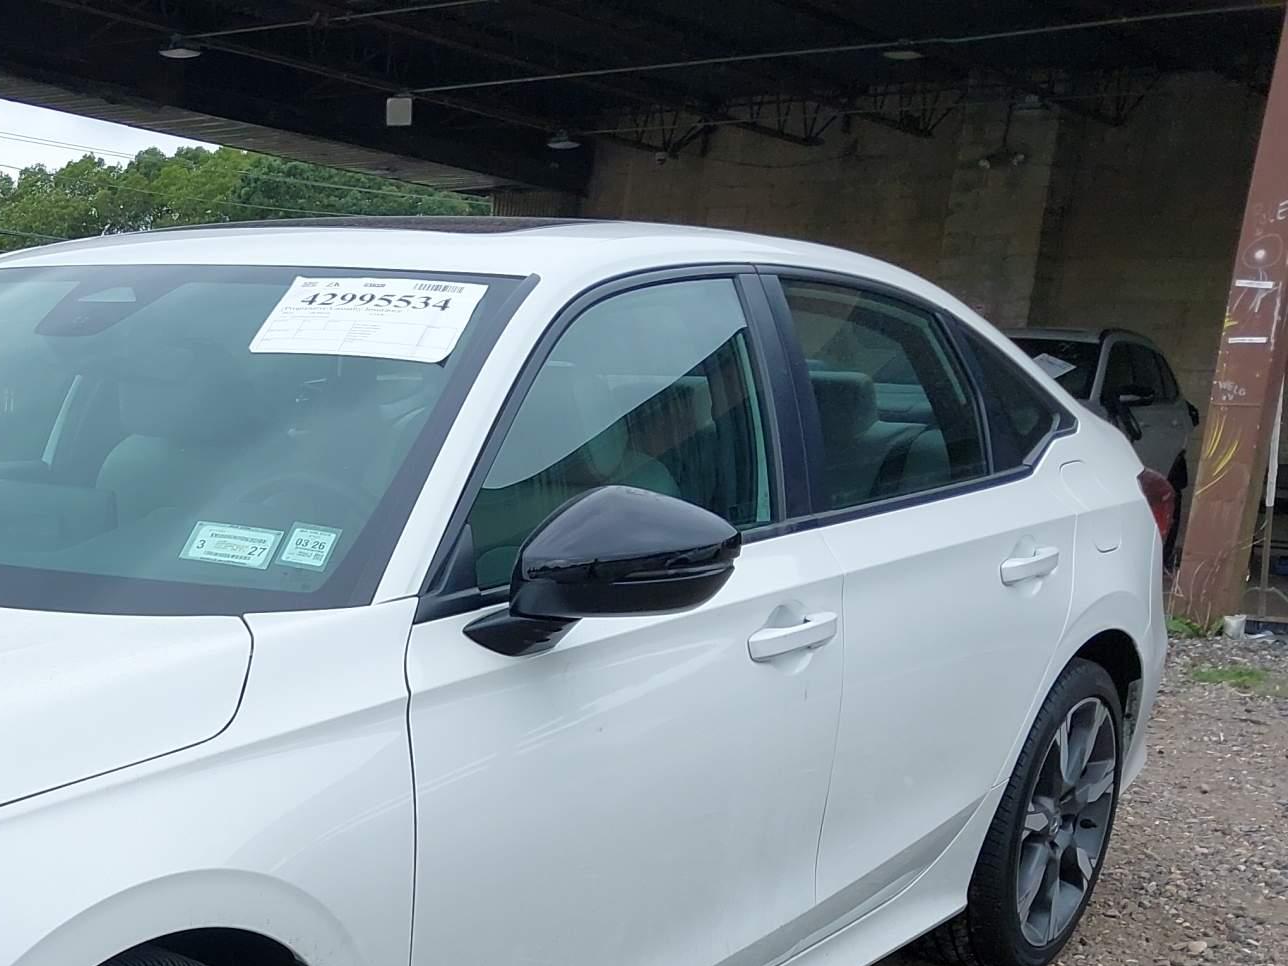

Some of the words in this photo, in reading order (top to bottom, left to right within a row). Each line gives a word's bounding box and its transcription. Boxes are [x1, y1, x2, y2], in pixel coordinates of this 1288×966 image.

[299, 292, 452, 311] 42995534
[196, 539, 206, 549] 3
[248, 545, 267, 557] 27
[295, 537, 310, 547] 03
[311, 540, 327, 550] 26
